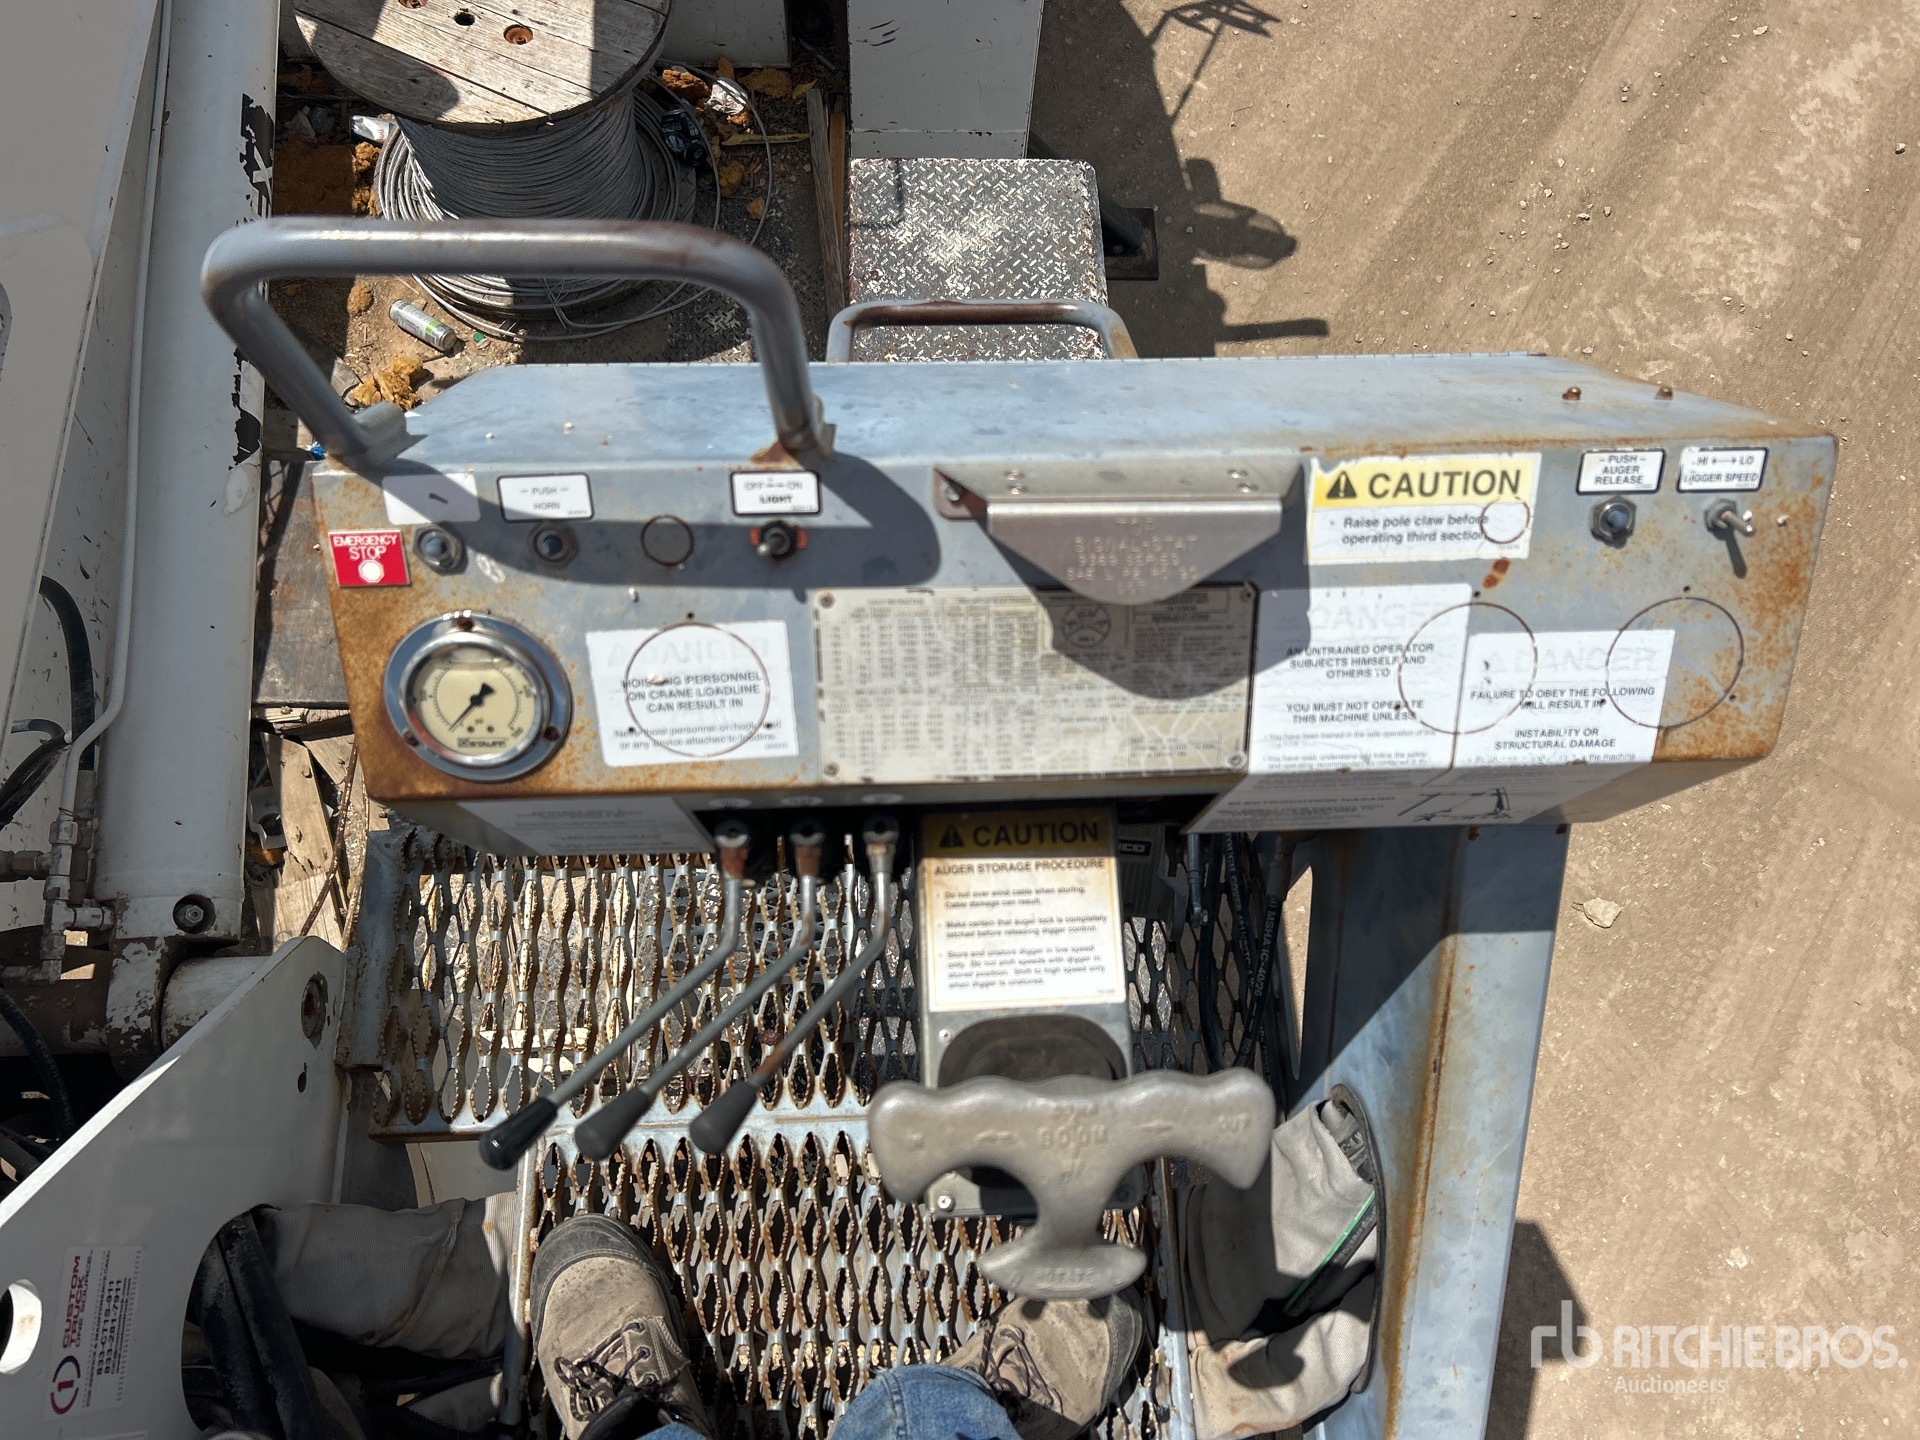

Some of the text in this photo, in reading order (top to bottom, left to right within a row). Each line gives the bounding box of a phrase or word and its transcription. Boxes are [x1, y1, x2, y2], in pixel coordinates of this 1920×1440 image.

[1608, 455, 1637, 463] PUSH
[1697, 456, 1754, 465] HI LO
[1602, 466, 1640, 475] AUGER
[1594, 476, 1643, 485] RELEASE
[1725, 473, 1758, 482] SPEED
[788, 482, 803, 490] ON
[1368, 469, 1521, 499] CAUTION
[531, 487, 558, 495] PUSH
[532, 502, 561, 510] HORN
[760, 496, 793, 504] LIGHT
[1343, 512, 1490, 530] Raise pole claw before
[333, 535, 398, 547] EMERGENCY
[1342, 531, 1402, 546] operating
[1407, 531, 1437, 543] third
[349, 546, 388, 560] STOP
[1286, 647, 1304, 656] AN
[1305, 645, 1370, 656] UNTRAINED
[1289, 655, 1426, 668] SUBJECTS HIMSELF AND
[685, 671, 763, 685] PERSONNEL
[1326, 668, 1391, 679] OTHERS TO
[628, 684, 761, 701] ON CRANE LOADLINE
[1470, 689, 1515, 699] FAILURE
[1536, 688, 1565, 698] OBEY
[1569, 688, 1589, 697] THE
[1592, 686, 1655, 697] FOLLOWING
[648, 698, 744, 713] CAN RESULT IN
[1286, 703, 1310, 712] YOU
[1312, 702, 1344, 712] MUST
[1346, 702, 1369, 711] NOT
[1548, 699, 1589, 709] RESULT
[1292, 714, 1316, 724] THIS
[1319, 712, 1369, 723] MACHINE
[669, 723, 718, 737] personnel
[1268, 732, 1282, 741] You
[1382, 729, 1413, 739] operation
[1514, 728, 1600, 739] INSTABILITY OR
[686, 734, 728, 746] attached
[1494, 738, 1616, 750] STRUCTURAL DAMAGE
[1603, 752, 1637, 761] machine
[972, 821, 1098, 847] CAUTION
[934, 858, 1105, 876] AUGER STORAGE PROCEDURE
[1262, 910, 1277, 946] MSHA
[62, 1255, 81, 1349] CUSTOM
[70, 1275, 85, 1348] TRUCK
[75, 1317, 84, 1348] ONE
[105, 1279, 123, 1374] 833-281-7911
